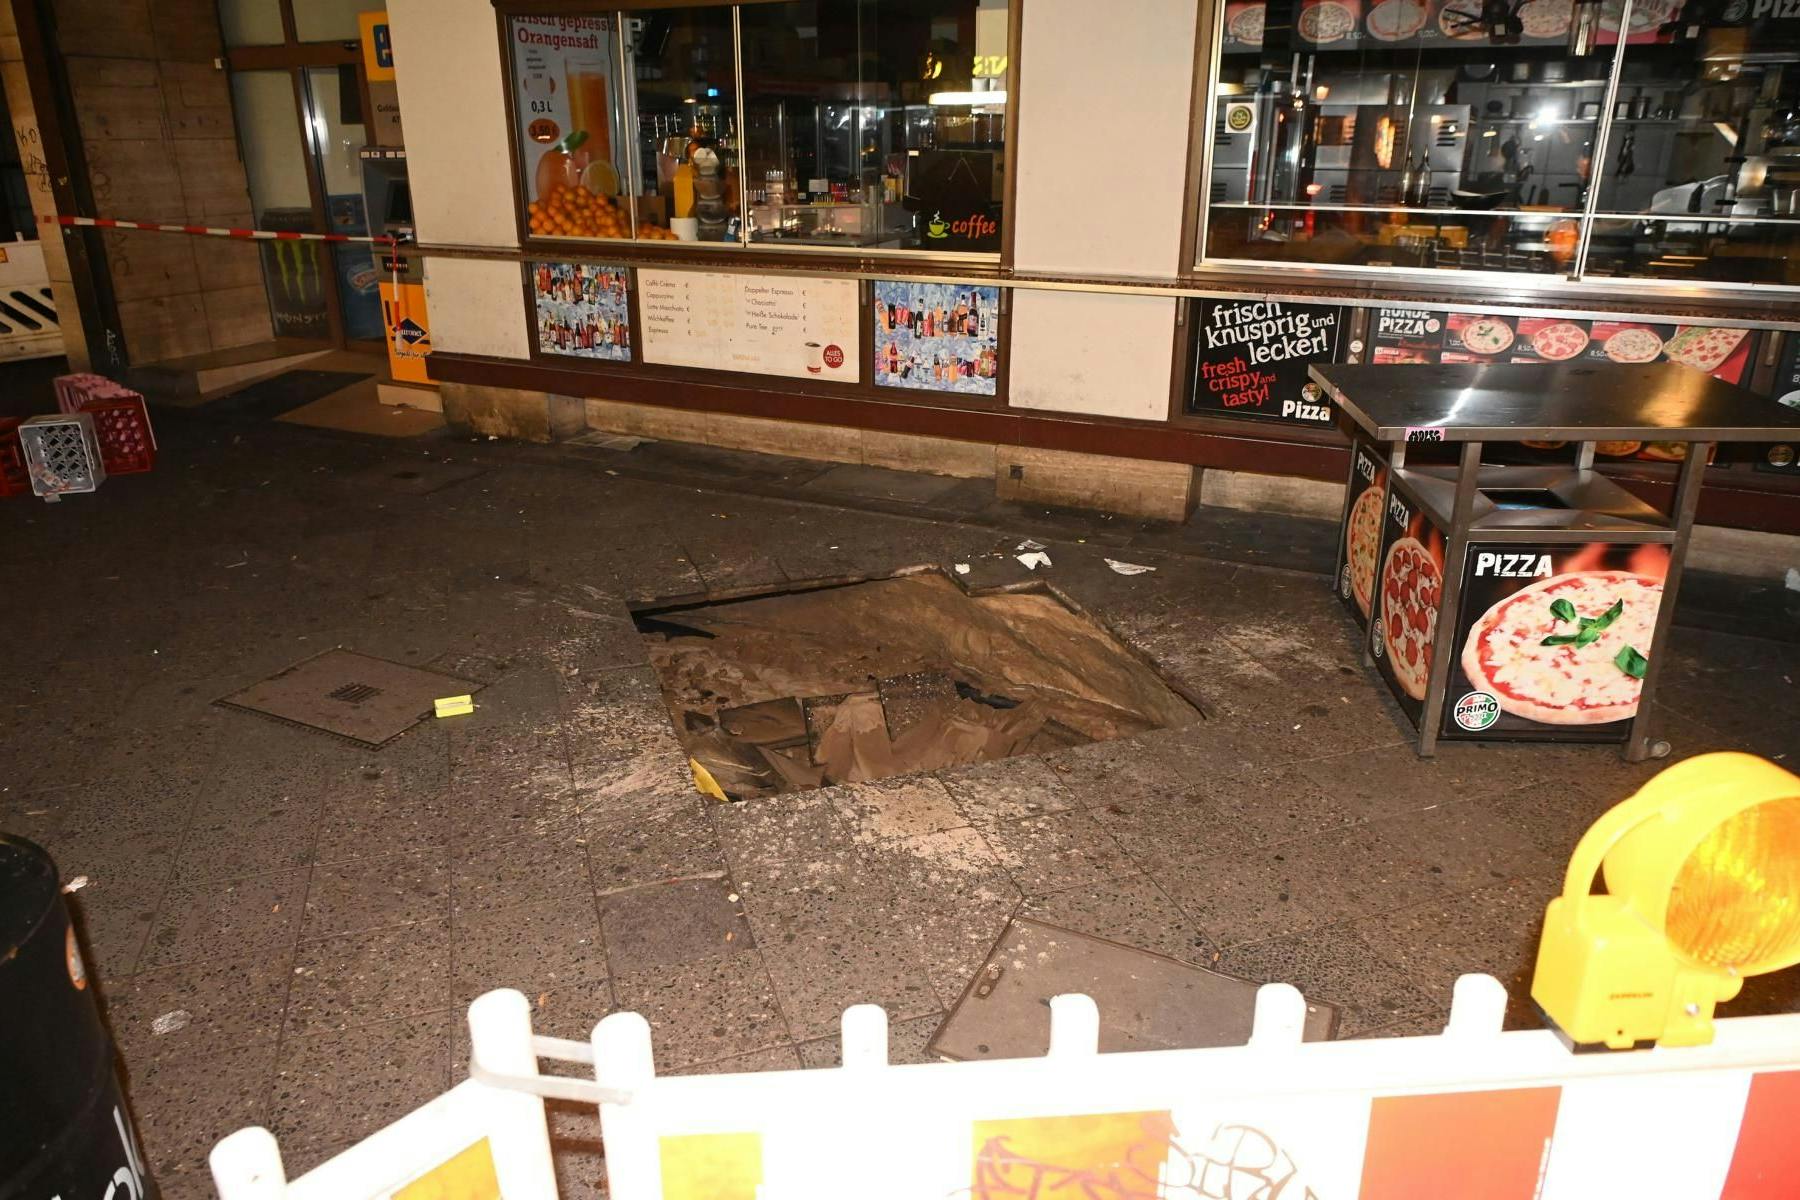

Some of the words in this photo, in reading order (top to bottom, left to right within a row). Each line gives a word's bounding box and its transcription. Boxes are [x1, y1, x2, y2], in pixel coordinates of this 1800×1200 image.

[517, 27, 598, 50] Orangensaft
[531, 100, 545, 114] 0,3
[951, 214, 997, 239] coffee
[1212, 303, 1282, 329] frisch
[1378, 316, 1425, 336] PIZZA
[1204, 311, 1312, 349] knusprig
[1311, 313, 1335, 329] und
[1248, 328, 1328, 365] lecker!
[1202, 357, 1247, 379] fresh
[1209, 372, 1261, 392] crispy
[1260, 374, 1276, 384] and
[1222, 384, 1269, 407] tasty!
[1282, 400, 1332, 421] Pizza
[1357, 452, 1375, 485] PIZZA
[1390, 494, 1409, 531] PIZZA
[1475, 553, 1553, 577] PIZZA
[1456, 701, 1499, 718] PRIMO
